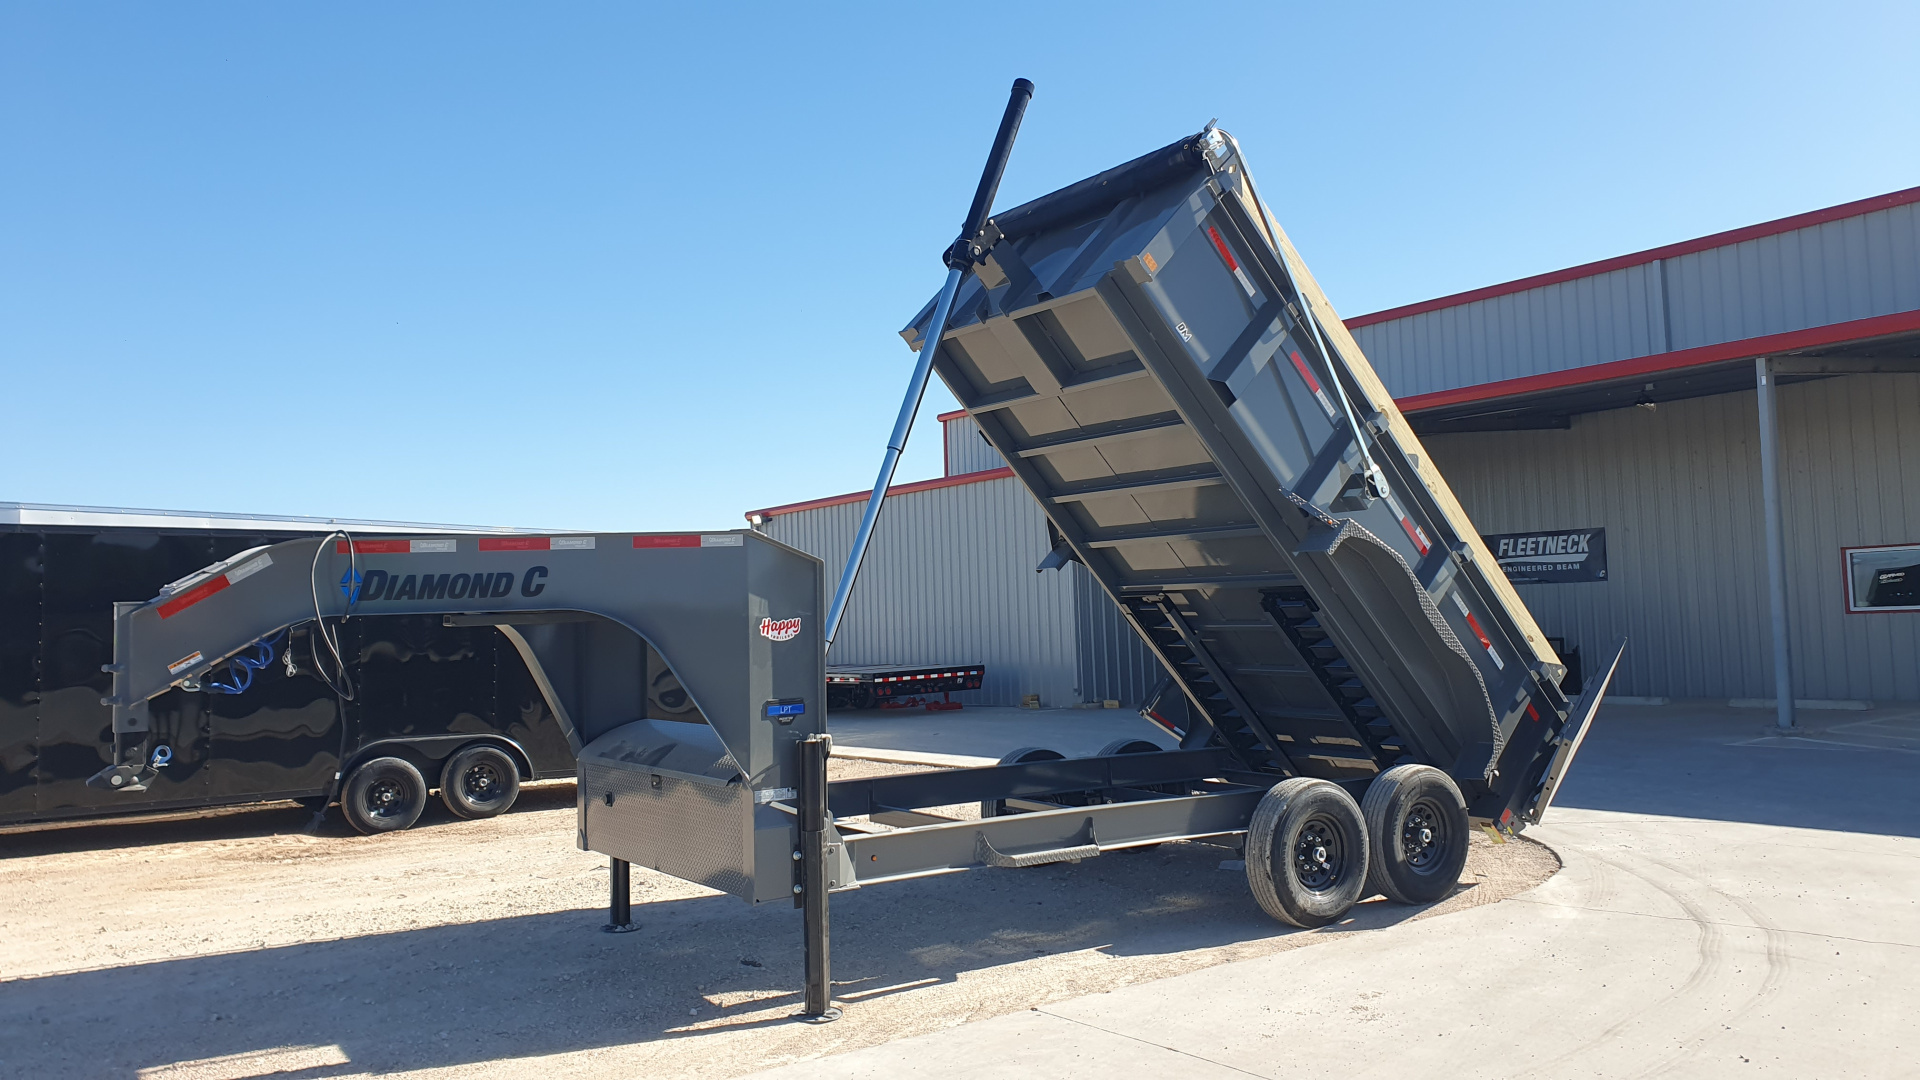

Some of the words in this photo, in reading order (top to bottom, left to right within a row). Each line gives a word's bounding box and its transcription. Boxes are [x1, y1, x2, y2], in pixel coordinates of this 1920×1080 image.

[1498, 533, 1592, 556] FLEETNECK
[1502, 564, 1554, 574] ENGINEERED
[1556, 563, 1580, 571] BEAM
[357, 569, 515, 602] DIAMOND
[520, 565, 549, 598] C
[761, 618, 801, 636] Happy
[780, 705, 793, 714] LPT
